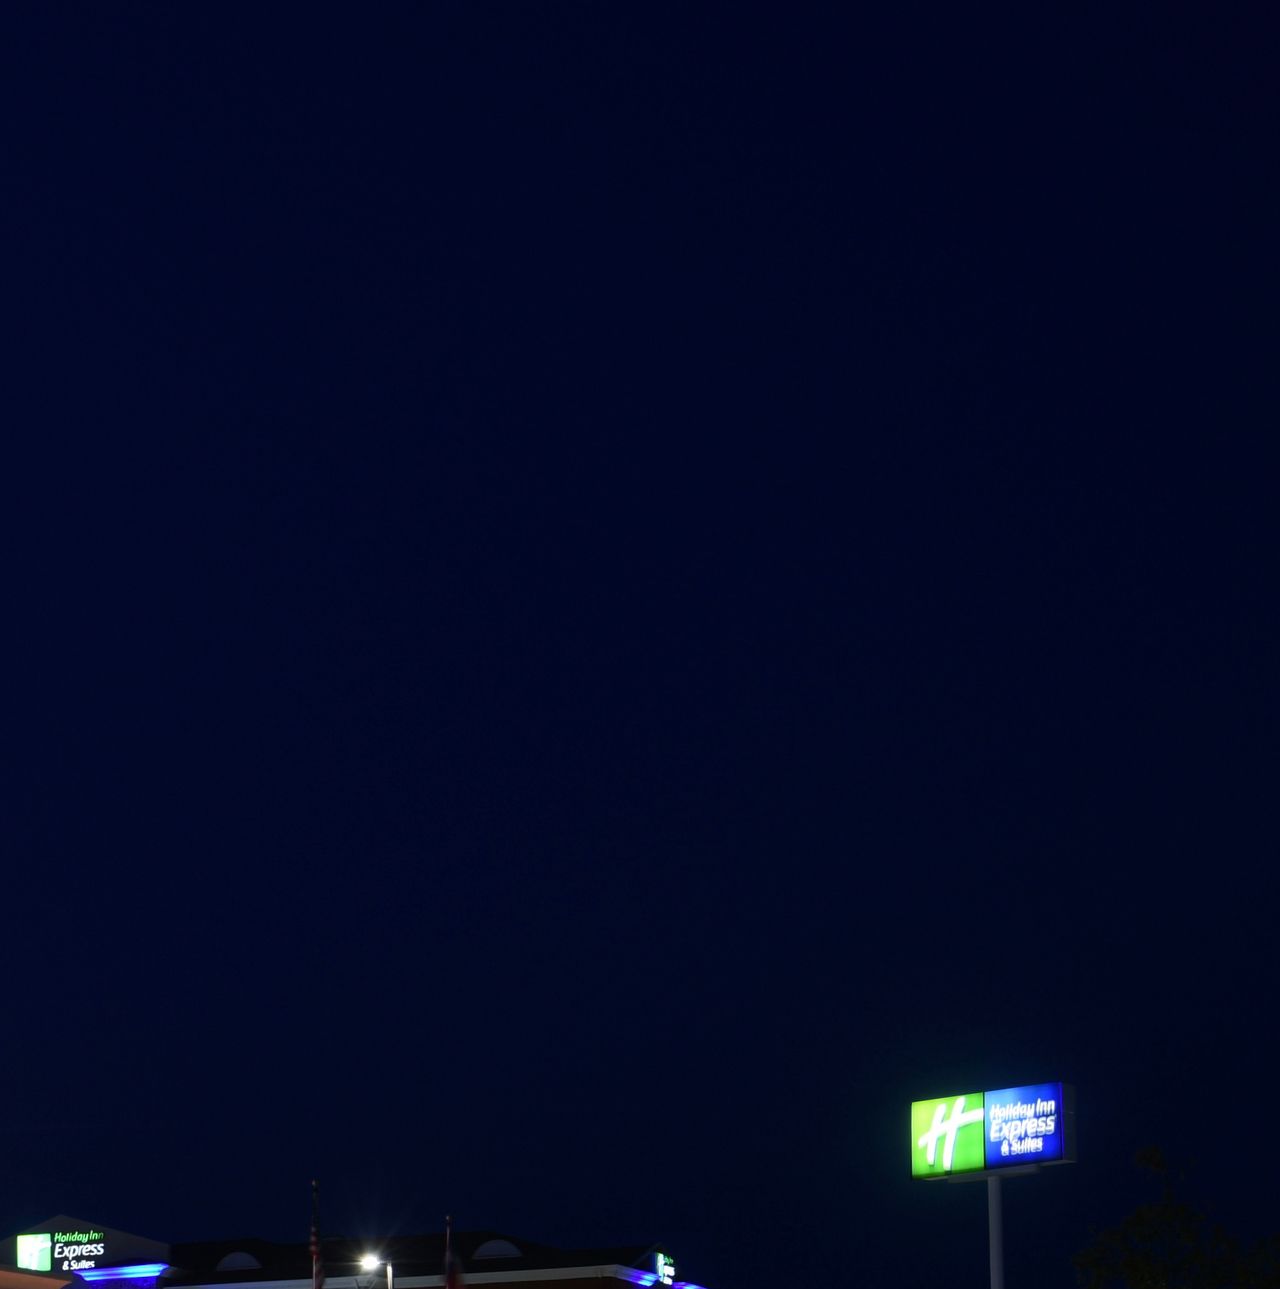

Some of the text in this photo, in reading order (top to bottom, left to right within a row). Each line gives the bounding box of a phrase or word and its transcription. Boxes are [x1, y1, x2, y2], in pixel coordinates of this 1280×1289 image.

[989, 1098, 1056, 1120] Holiday Inn
[990, 1115, 1056, 1142] Express
[1001, 1137, 1043, 1156] & Suites
[54, 1229, 105, 1243] Holiday Inn
[54, 1242, 105, 1260] Express
[62, 1259, 95, 1271] & Suites
